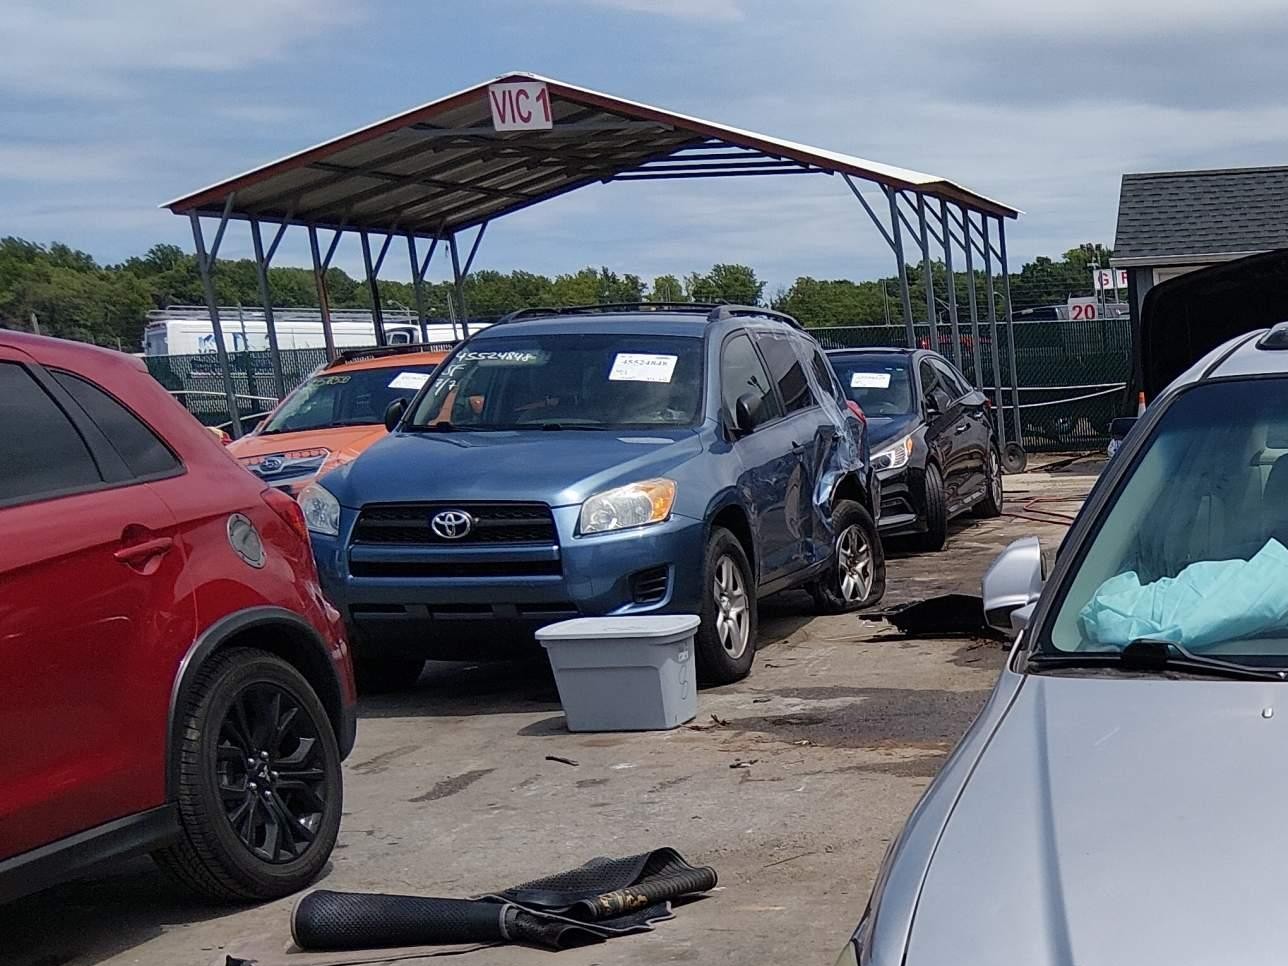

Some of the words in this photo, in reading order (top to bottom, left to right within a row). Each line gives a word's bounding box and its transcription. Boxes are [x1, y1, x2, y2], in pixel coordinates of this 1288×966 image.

[491, 88, 532, 124] VIC
[535, 87, 550, 122] 1
[1072, 304, 1096, 320] 20
